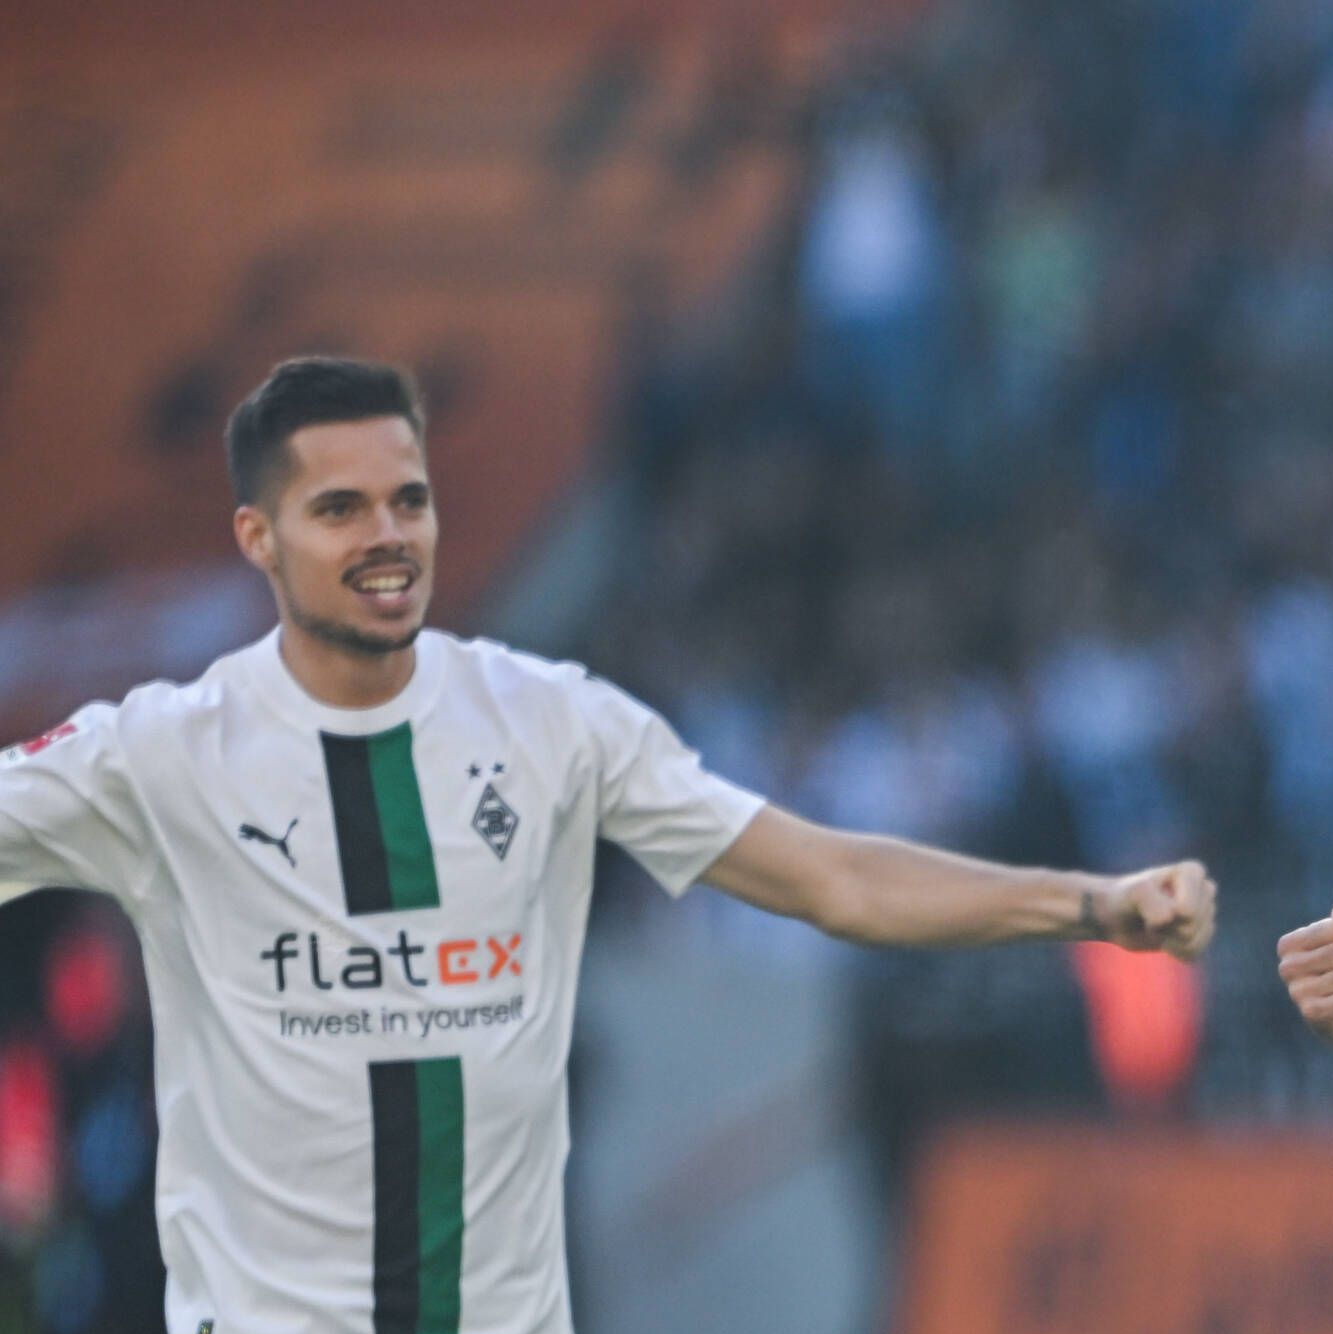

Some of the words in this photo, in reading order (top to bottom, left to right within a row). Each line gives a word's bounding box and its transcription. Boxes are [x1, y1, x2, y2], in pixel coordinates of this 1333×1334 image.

[279, 1007, 372, 1036] Invest
[381, 1005, 407, 1033] in
[417, 995, 524, 1037] yourself
